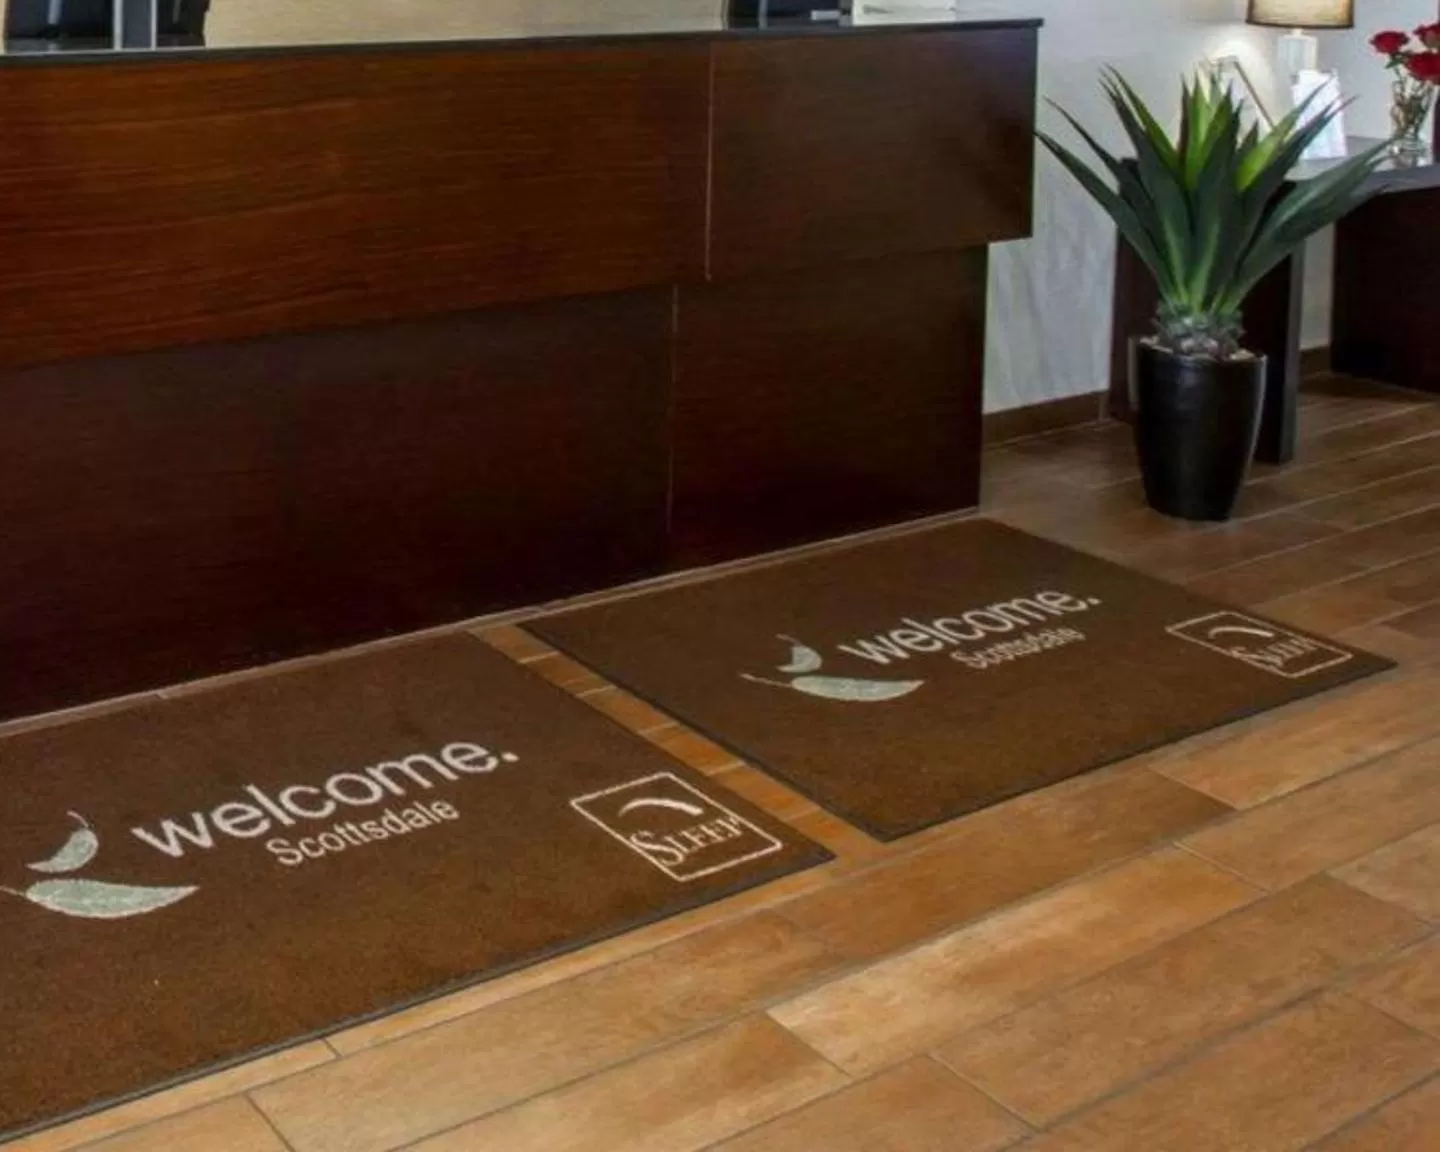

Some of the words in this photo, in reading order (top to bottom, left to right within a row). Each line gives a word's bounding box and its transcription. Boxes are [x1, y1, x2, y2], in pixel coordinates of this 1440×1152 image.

[837, 591, 1101, 665] welcome.
[131, 741, 519, 859] welcome.
[266, 799, 460, 866] Scottsdale
